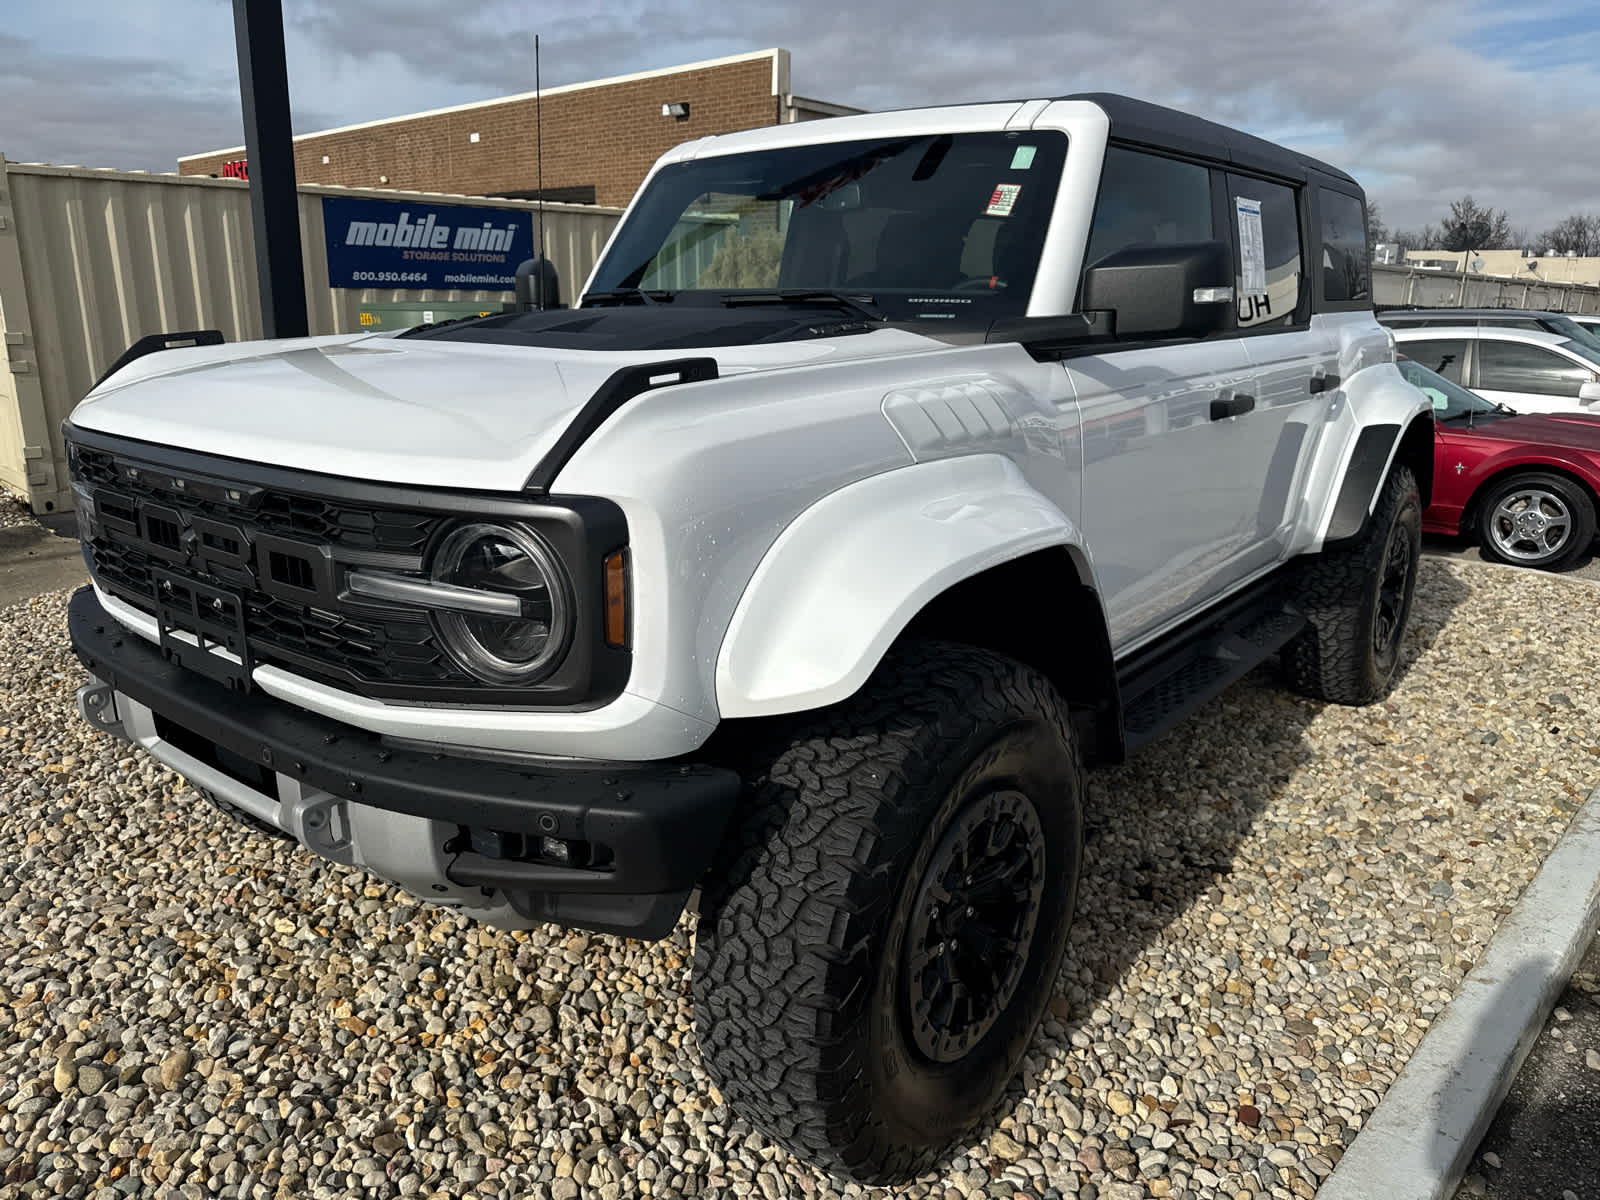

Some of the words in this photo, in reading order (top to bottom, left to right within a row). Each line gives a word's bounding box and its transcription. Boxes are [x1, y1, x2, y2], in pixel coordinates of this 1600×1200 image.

[345, 212, 450, 249] mobile
[453, 222, 516, 252] mini
[402, 250, 450, 261] STORAGE
[452, 251, 506, 263] SOLUTIONS
[352, 271, 428, 282] 800.950.6464
[94, 488, 336, 609] FORD
